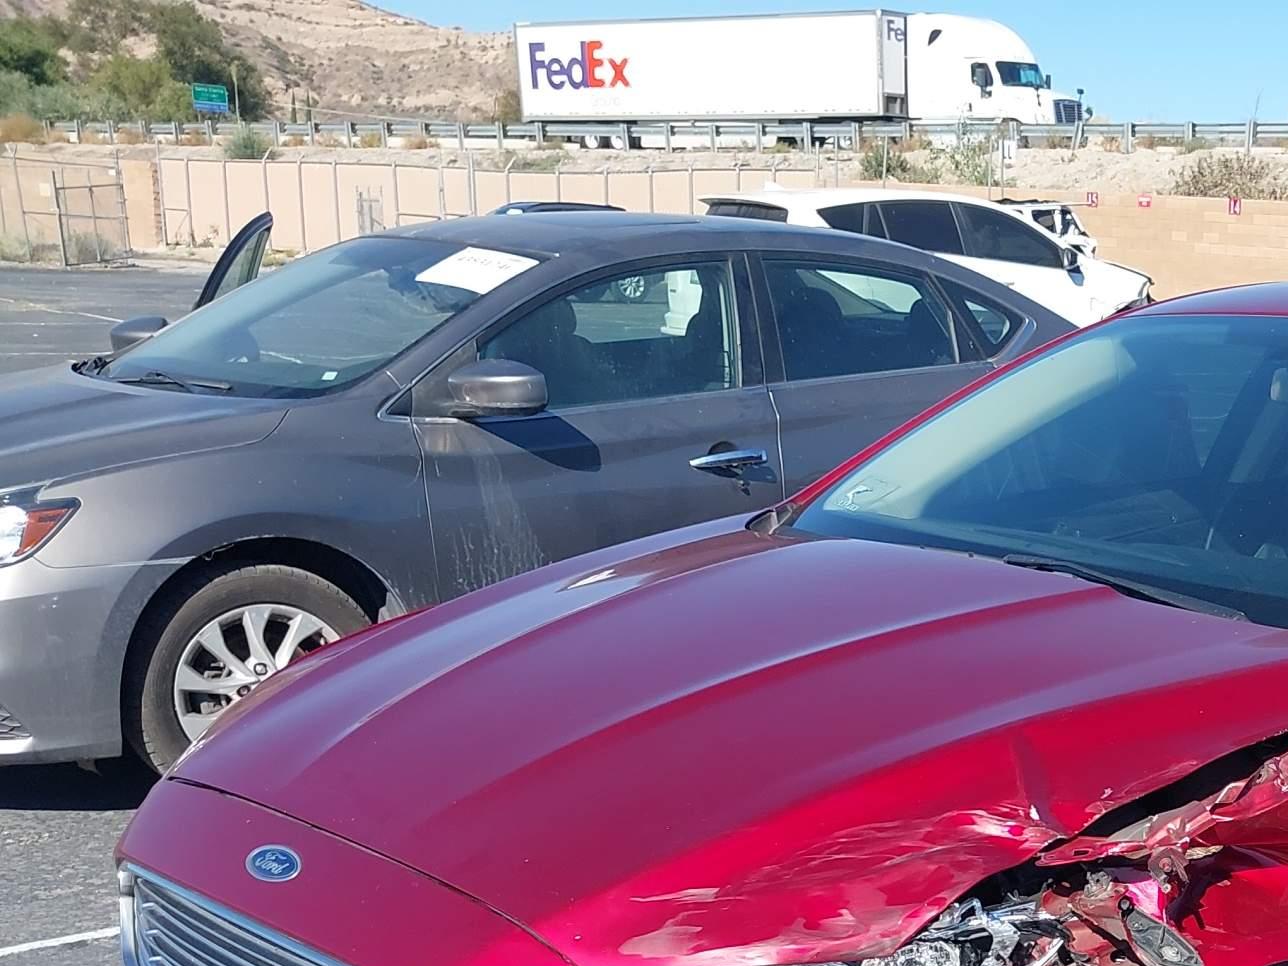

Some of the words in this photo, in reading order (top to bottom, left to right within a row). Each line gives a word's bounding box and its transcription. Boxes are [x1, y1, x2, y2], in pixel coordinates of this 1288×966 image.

[528, 40, 631, 90] FedEx
[1230, 198, 1240, 214] 14
[255, 850, 290, 875] Ford
